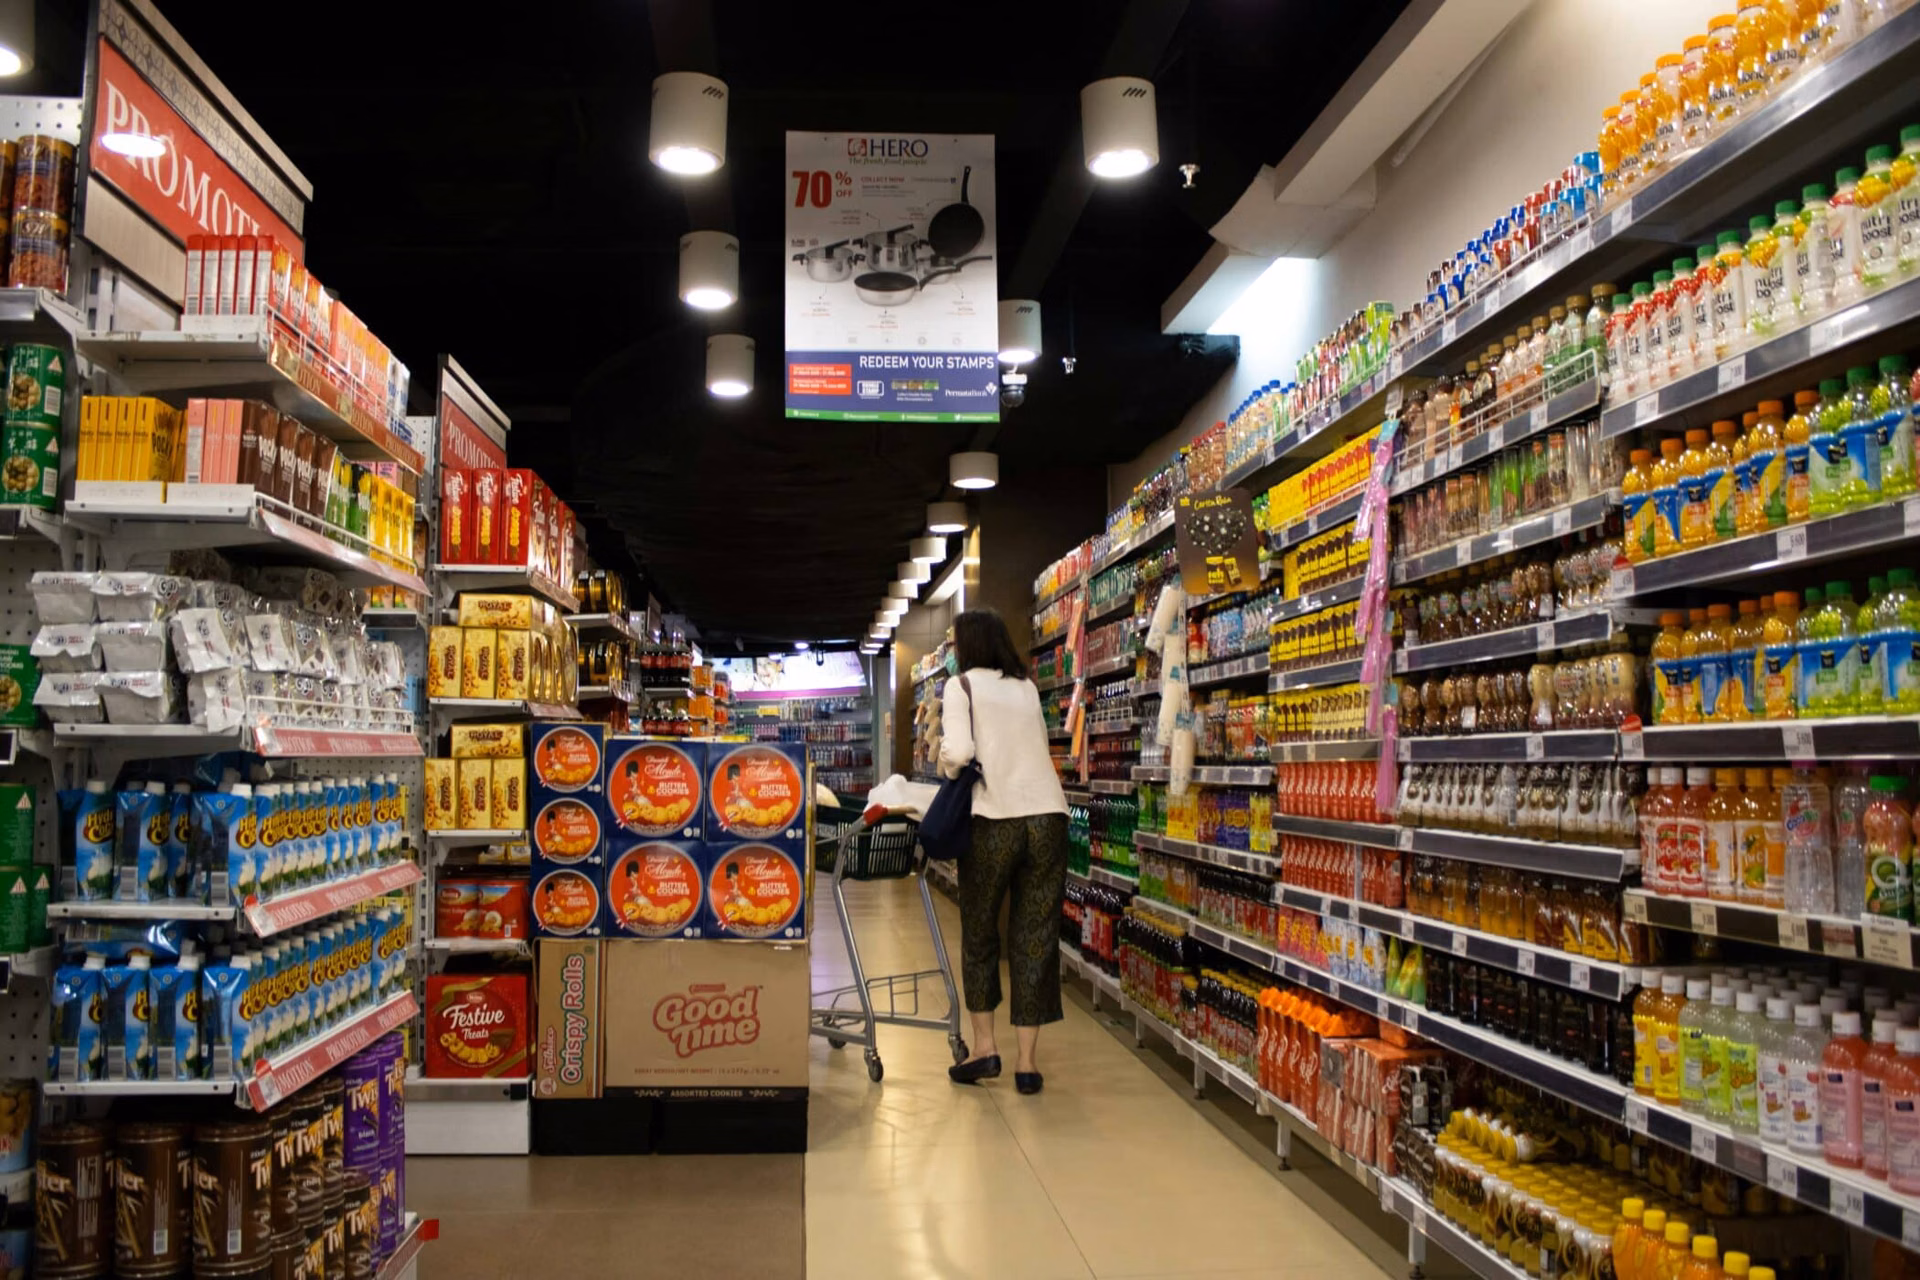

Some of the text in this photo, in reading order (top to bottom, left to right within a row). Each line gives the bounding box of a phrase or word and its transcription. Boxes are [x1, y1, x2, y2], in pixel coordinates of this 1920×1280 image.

[870, 138, 929, 158] HERO
[792, 170, 832, 208] 70
[836, 189, 852, 197] OFF
[860, 356, 995, 370] REDEEM YOUR STAMPS
[443, 1003, 505, 1030] Festive
[560, 955, 586, 1083] Crispy Rolls
[654, 987, 758, 1030] Good
[462, 1028, 489, 1040] Treats
[671, 1018, 757, 1057] Time
[670, 1089, 743, 1097] ASSORTED COOKIES
